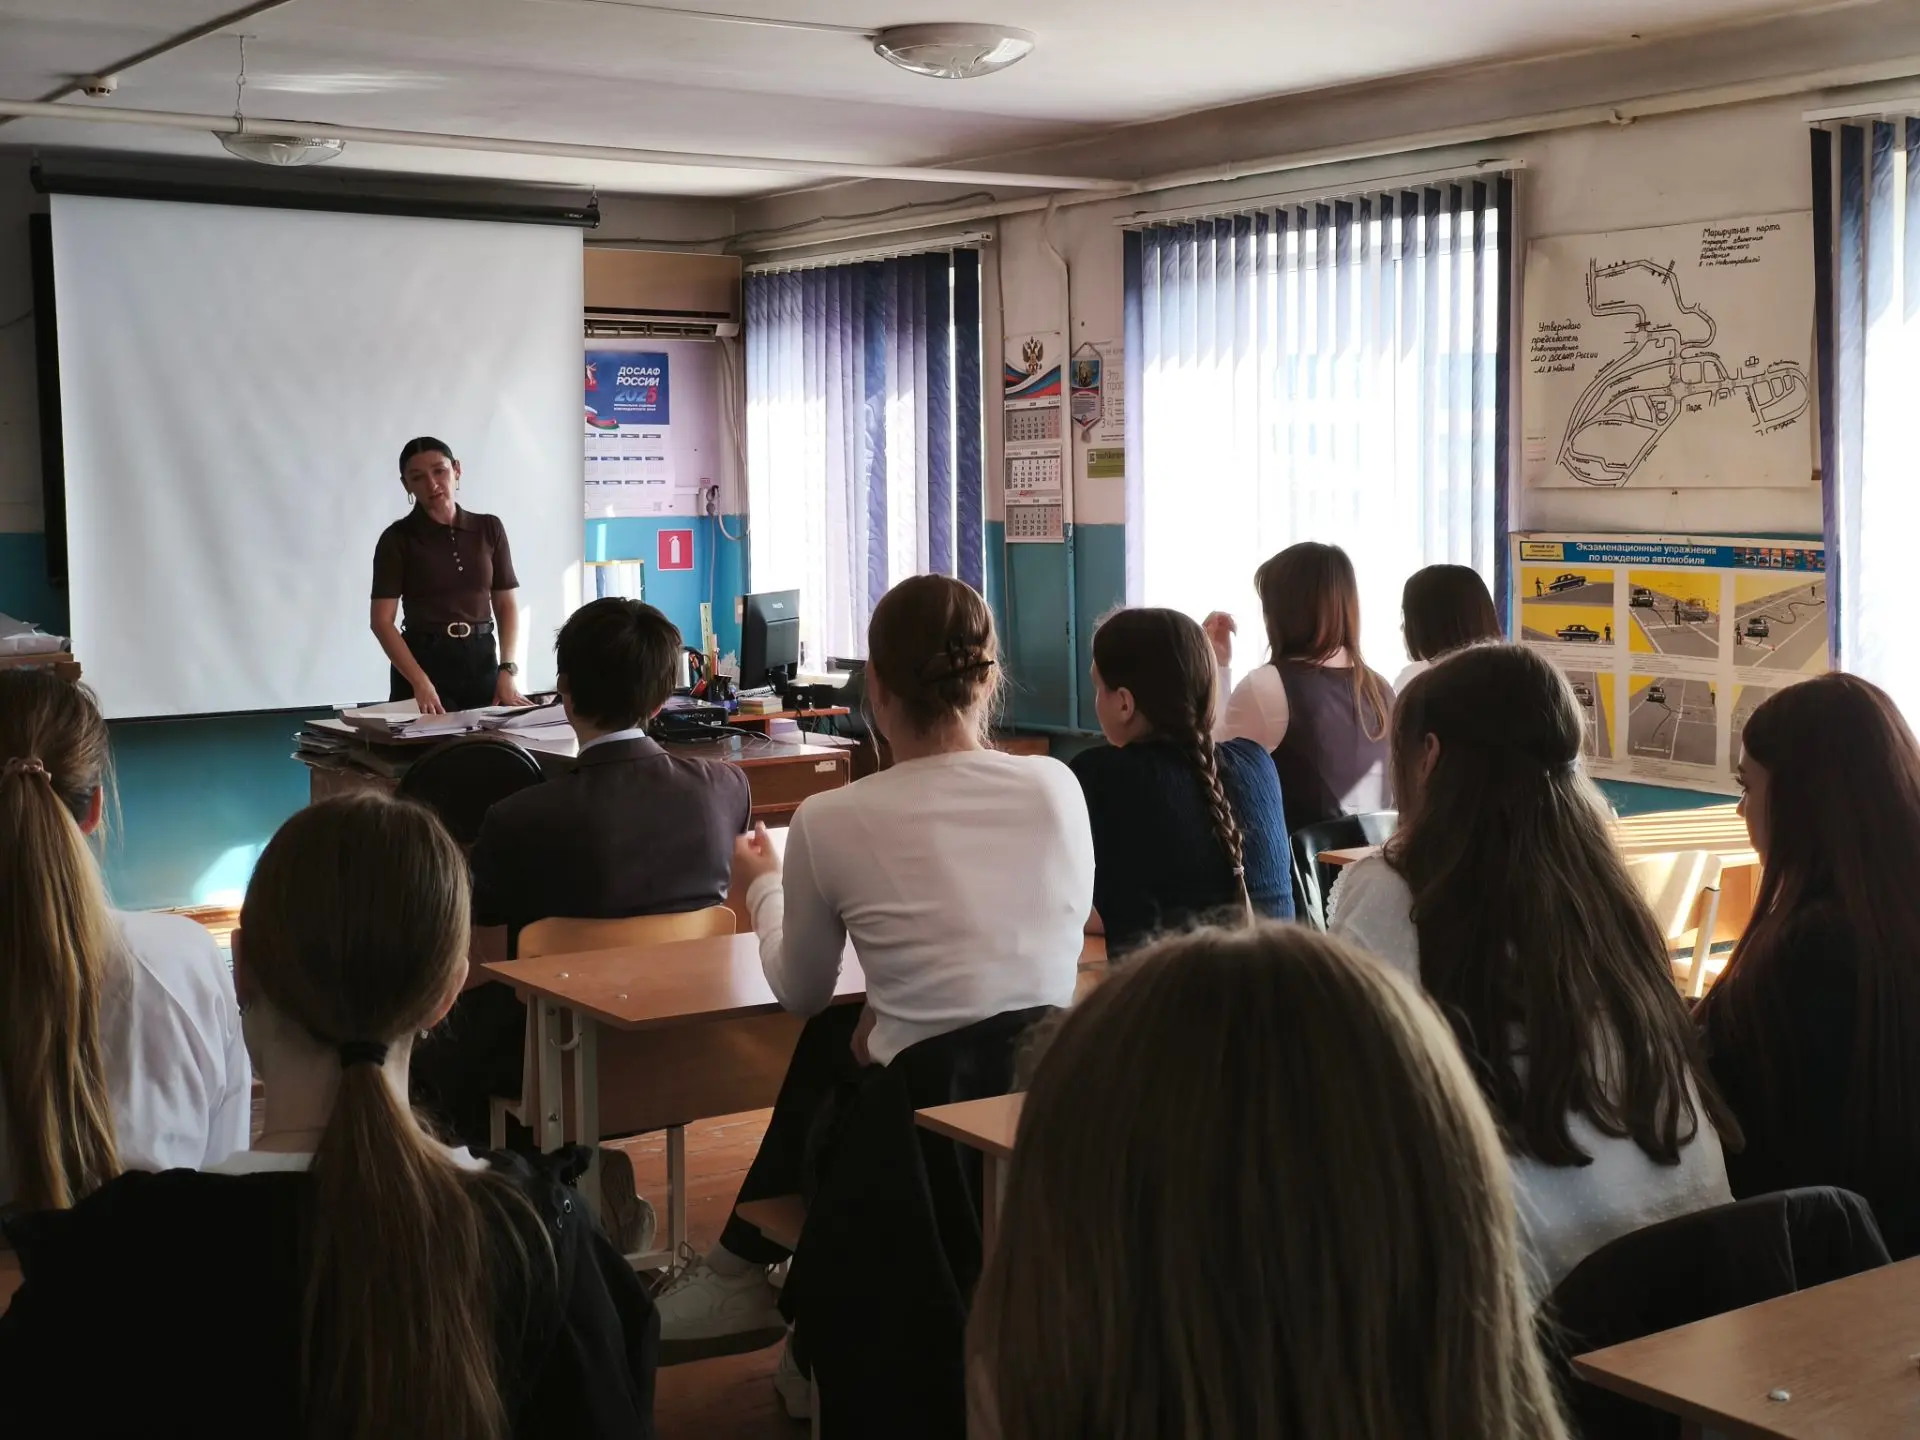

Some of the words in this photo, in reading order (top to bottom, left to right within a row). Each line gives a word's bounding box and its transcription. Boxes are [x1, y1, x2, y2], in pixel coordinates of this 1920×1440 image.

[1703, 226, 1750, 239] Маршрутная
[1538, 318, 1582, 336] Утверждаю
[617, 366, 661, 377] ДОСААФ
[616, 376, 660, 387] РОССИИ
[1686, 403, 1703, 414] Парк
[1576, 542, 1662, 553] Экзаменационные
[1664, 545, 1717, 555] упражнения
[1588, 554, 1601, 562] по
[1602, 554, 1650, 563] вождению
[1651, 554, 1706, 565] автомобиля
